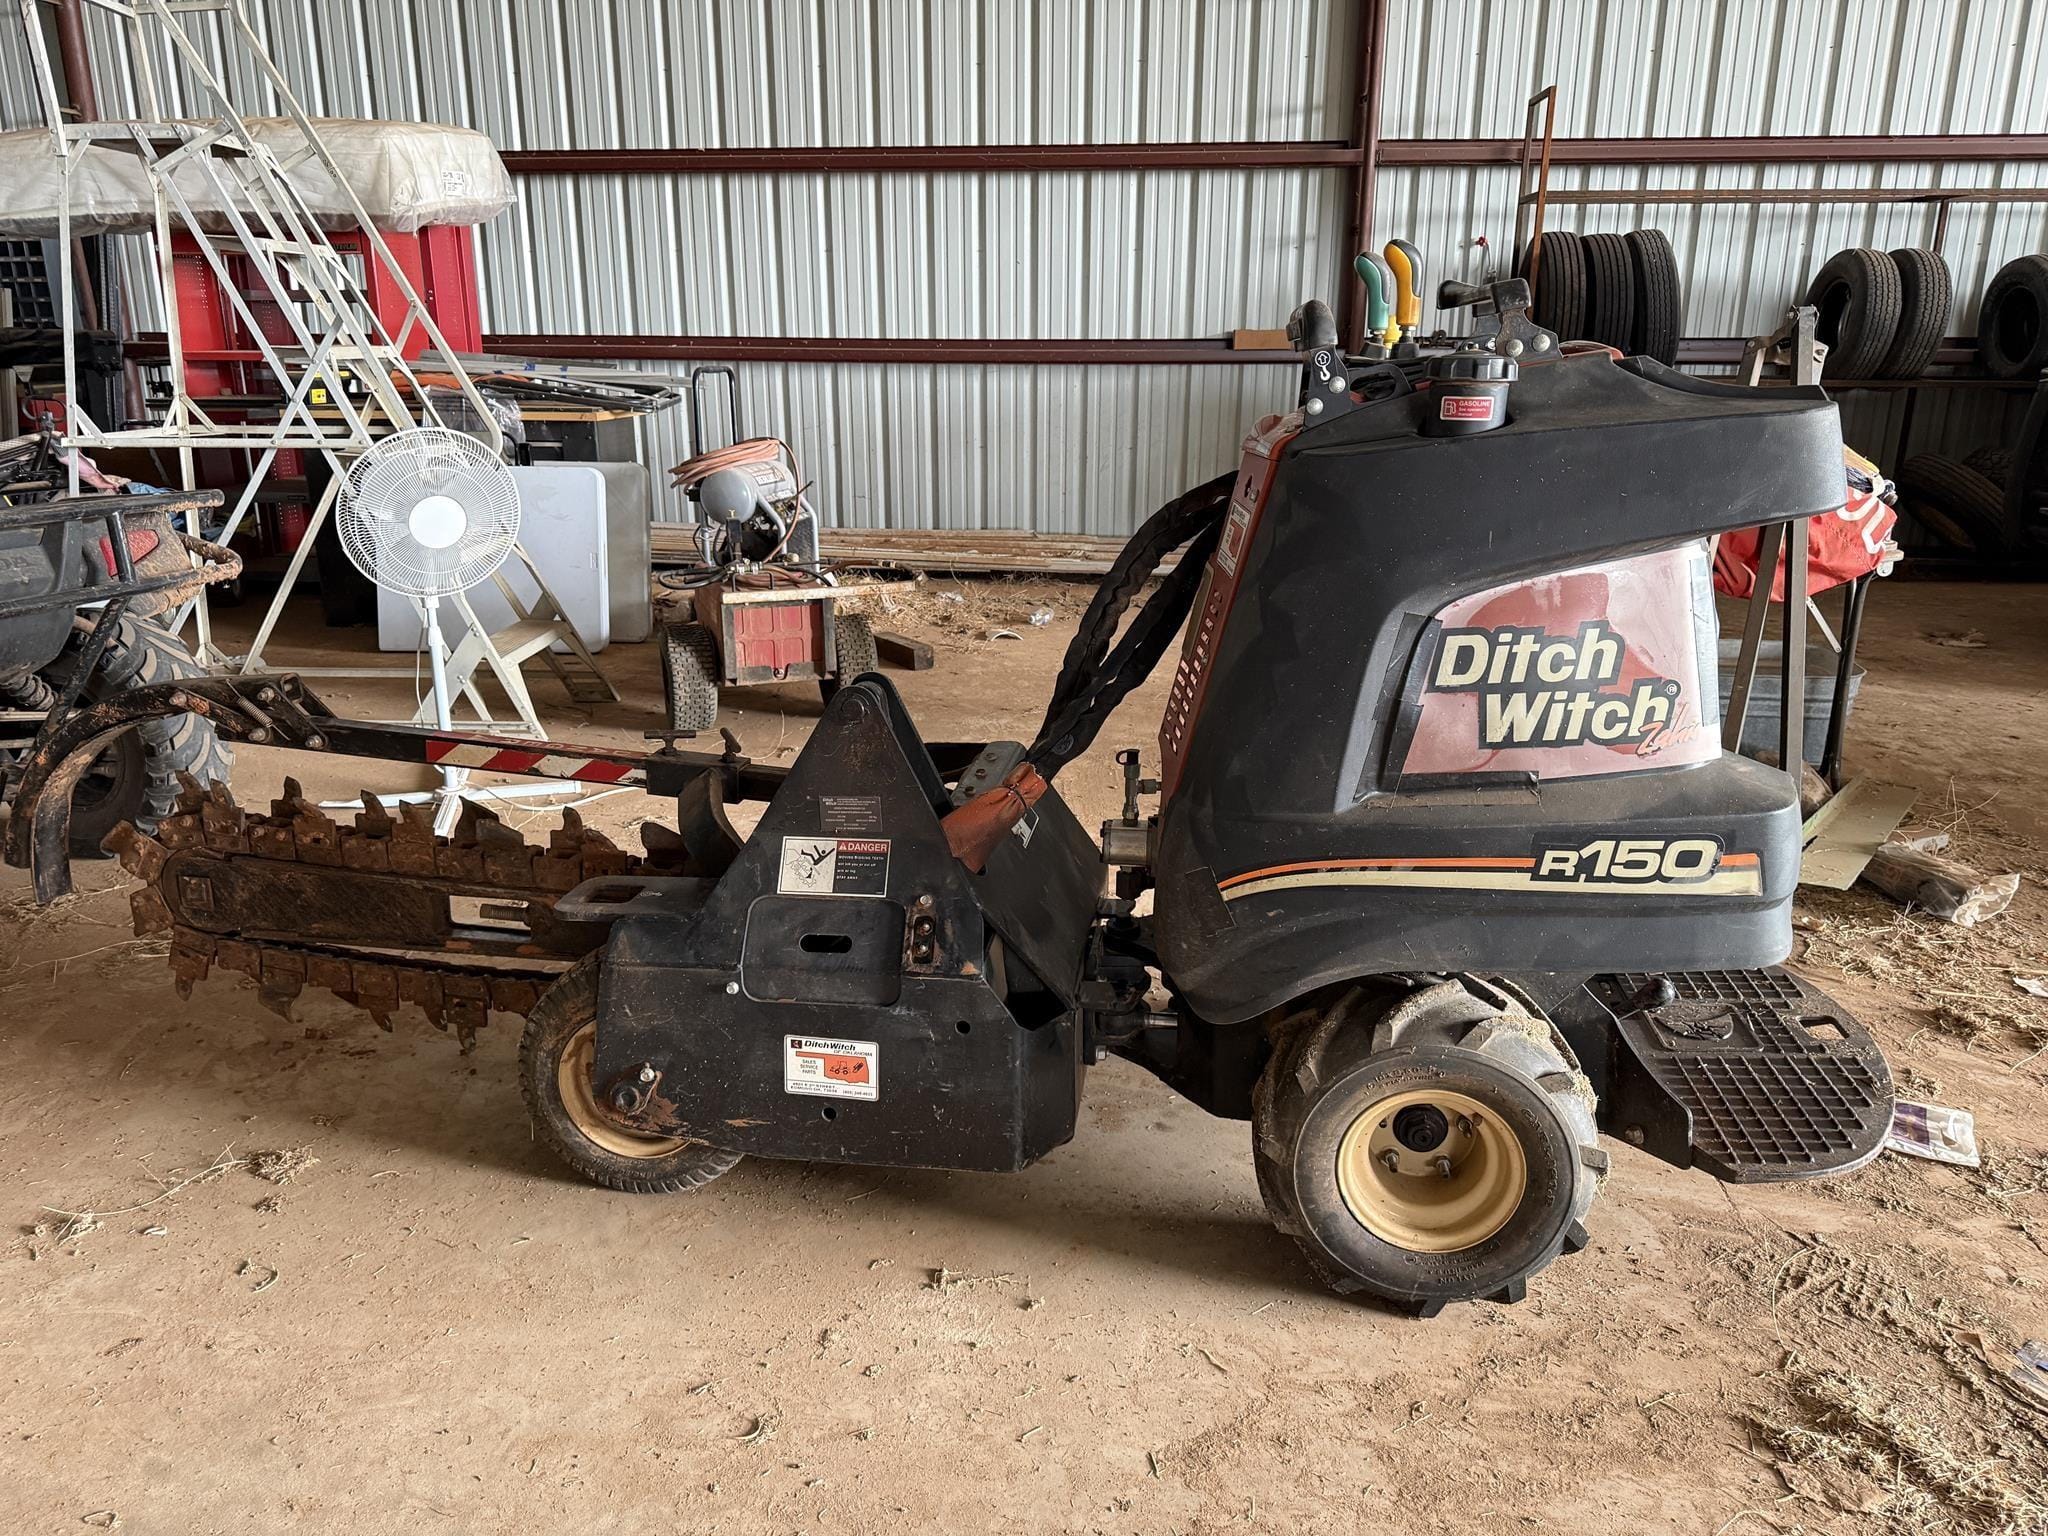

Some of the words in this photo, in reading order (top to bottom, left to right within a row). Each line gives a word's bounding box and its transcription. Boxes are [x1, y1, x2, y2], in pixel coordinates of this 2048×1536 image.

[1435, 628, 1618, 686] Ditch
[1486, 685, 1668, 743] Witch
[848, 842, 887, 852] DANGER
[1539, 839, 1718, 878] R150
